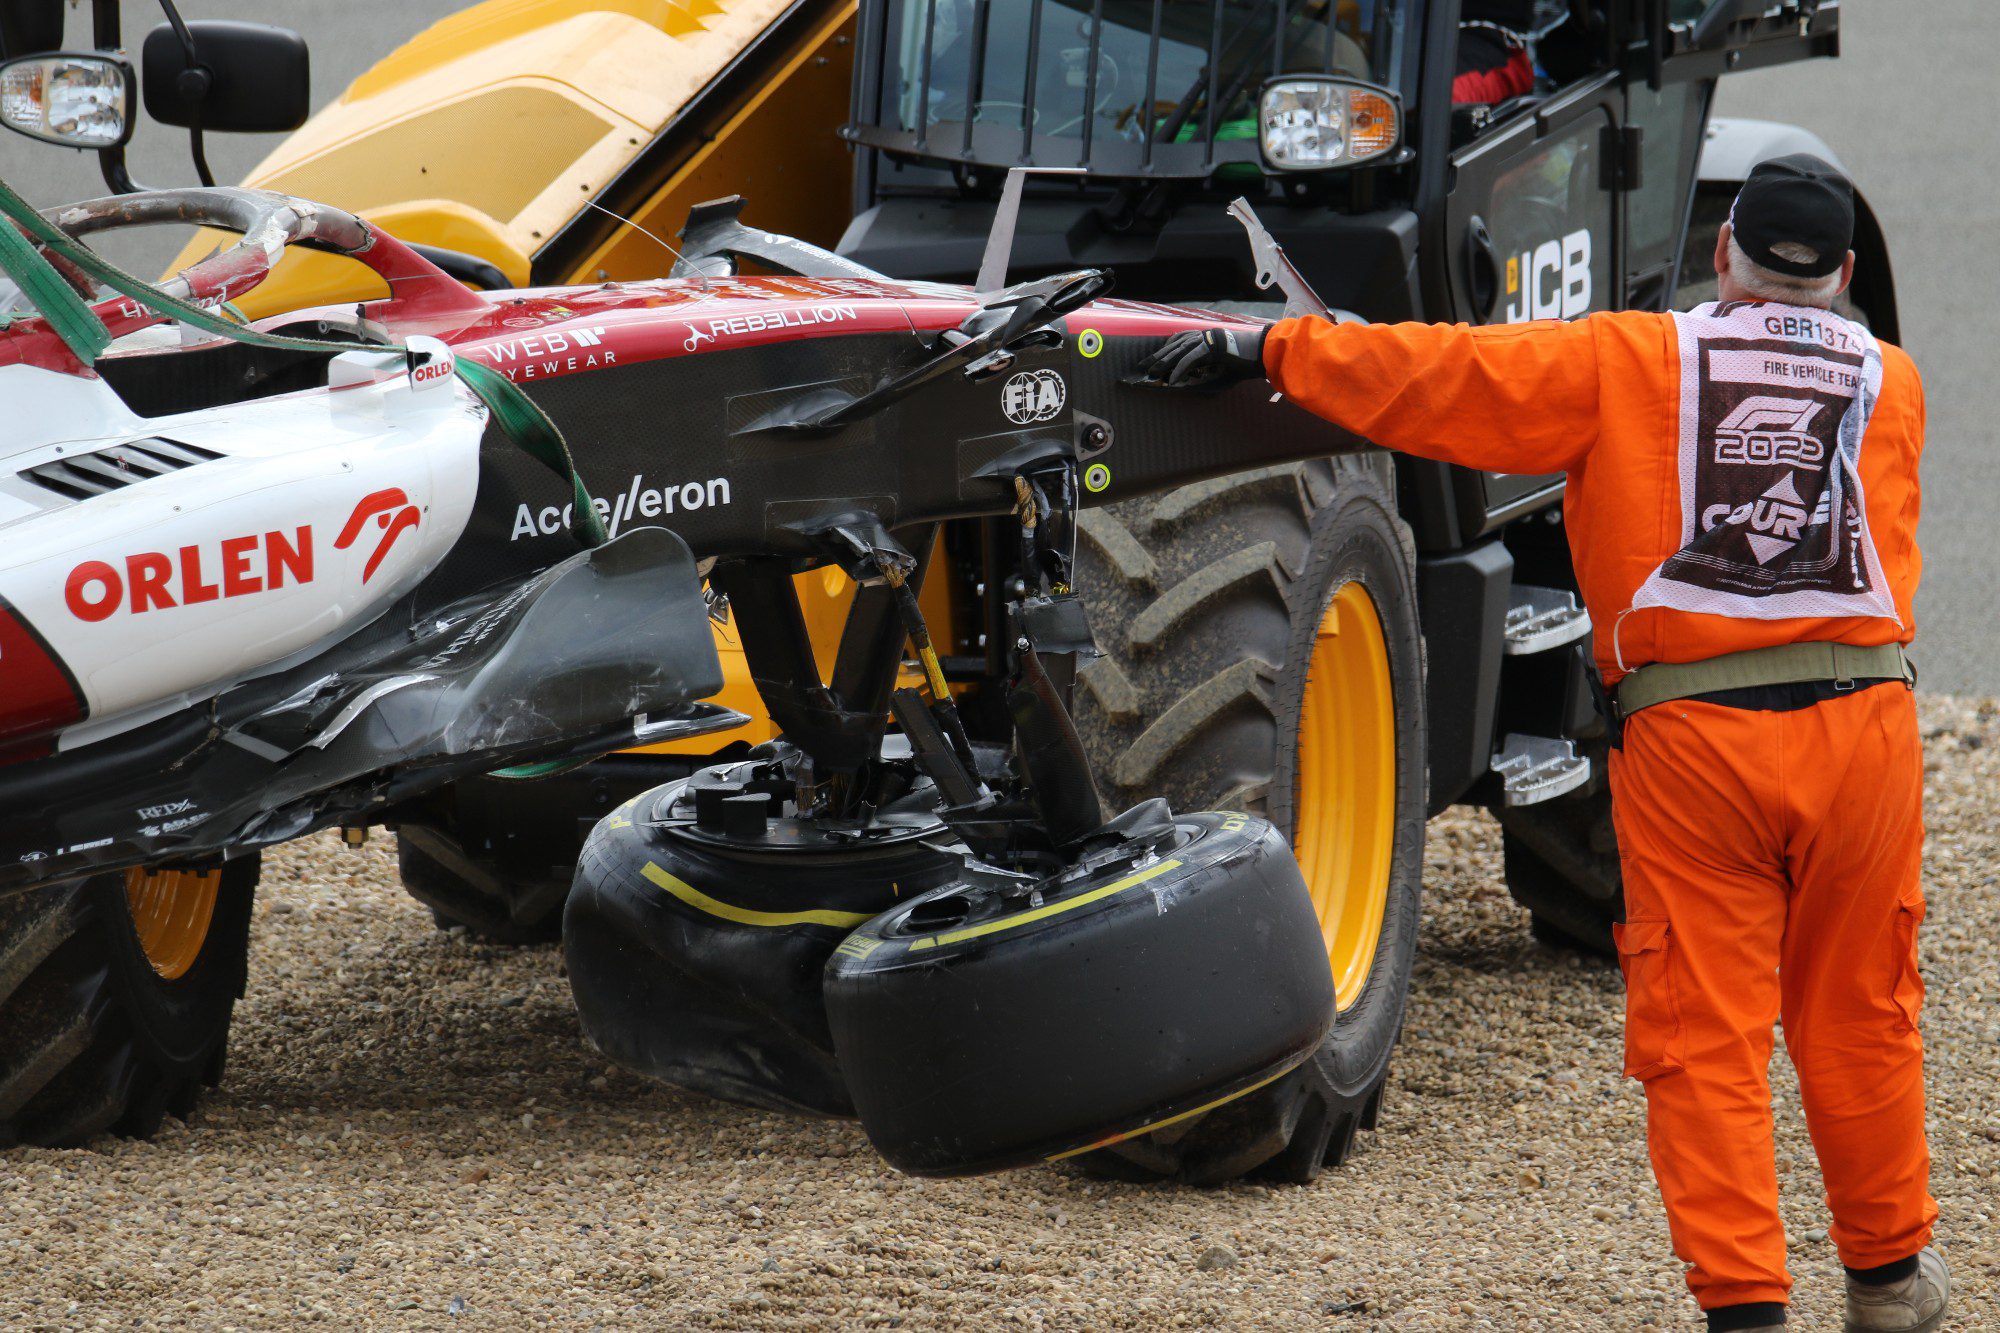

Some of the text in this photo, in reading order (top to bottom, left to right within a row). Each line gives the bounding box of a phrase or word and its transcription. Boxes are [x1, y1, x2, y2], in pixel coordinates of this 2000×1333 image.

[1507, 228, 1592, 324] JCB
[709, 305, 858, 338] REBELLION
[487, 331, 570, 363] WEB
[415, 361, 453, 382] ORLEN
[498, 351, 617, 381] YEWEAR
[1764, 360, 1790, 376] FIRE
[1792, 363, 1835, 385] VEHICLE
[1702, 490, 1830, 541] COURE
[64, 524, 314, 623] ORLEN
